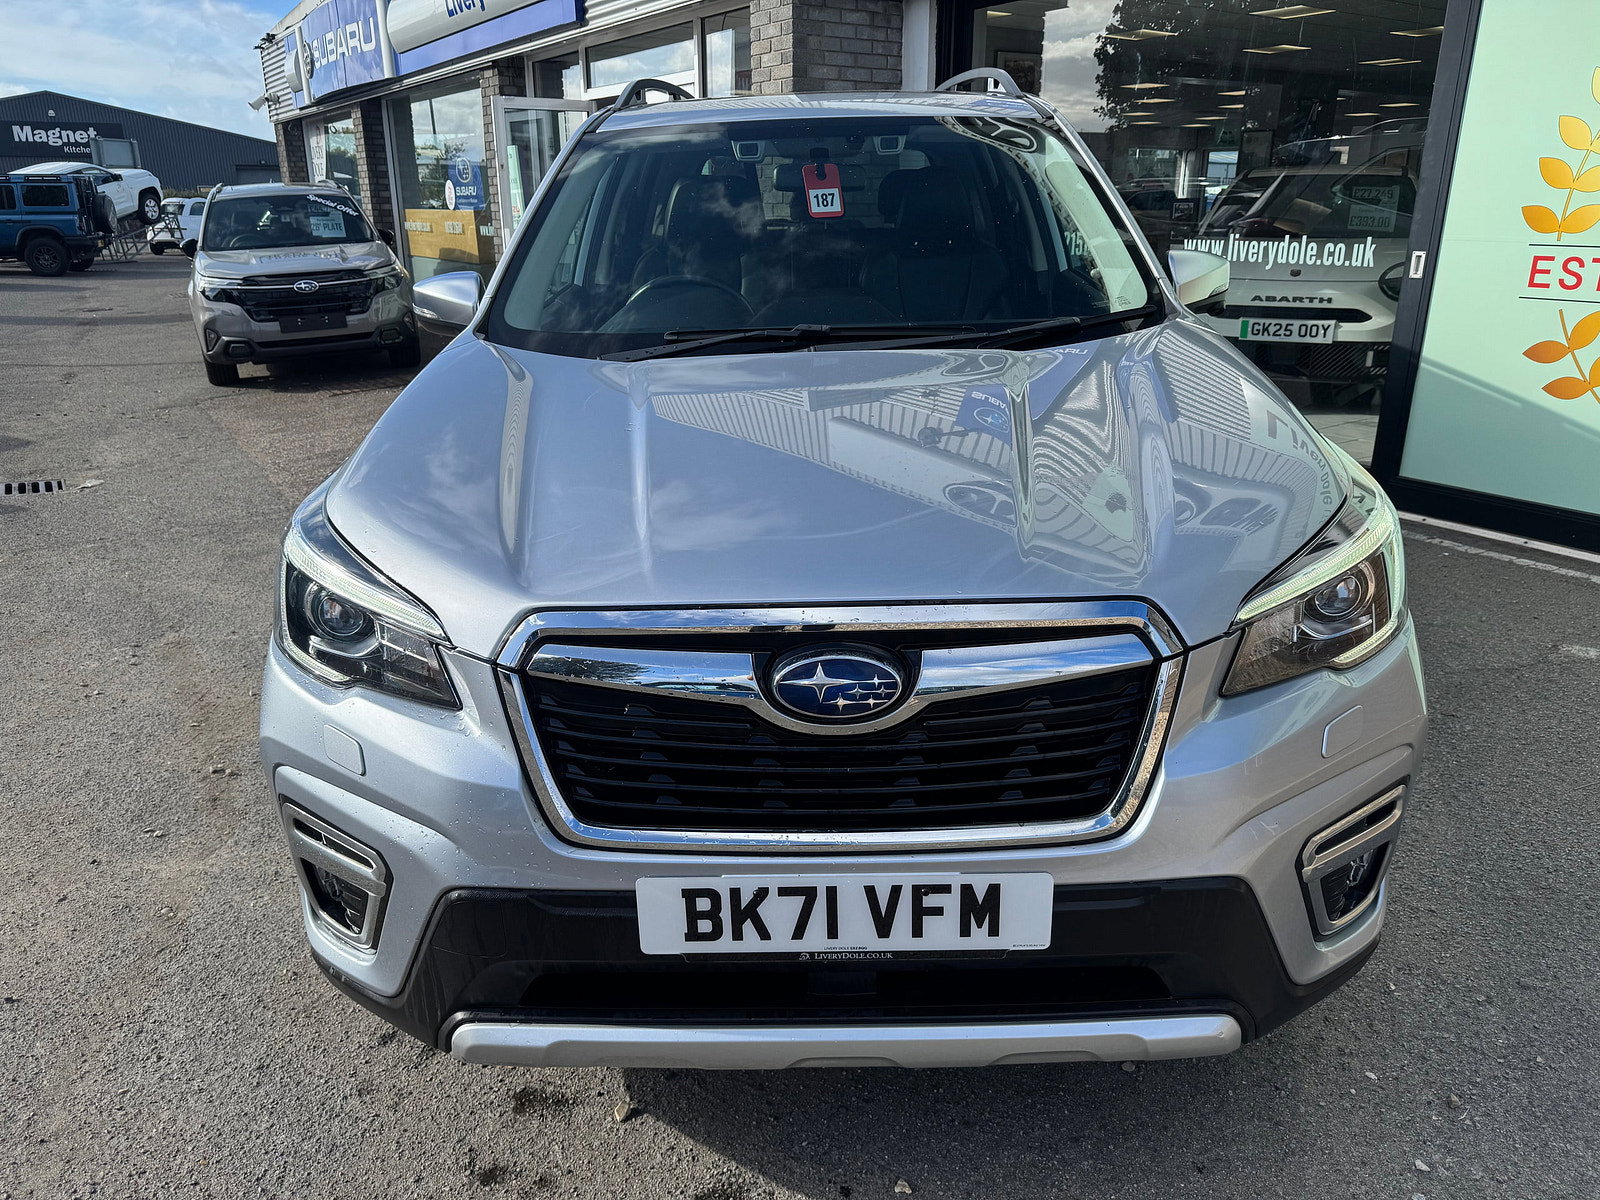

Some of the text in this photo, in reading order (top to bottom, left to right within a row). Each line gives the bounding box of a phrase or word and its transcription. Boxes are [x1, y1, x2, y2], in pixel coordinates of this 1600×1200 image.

[312, 17, 376, 69] SUBARU
[12, 125, 97, 146] Magnet
[64, 146, 92, 154] Kitche
[456, 186, 477, 196] SUBARU
[306, 194, 337, 208] Special
[337, 204, 359, 216] Offer
[813, 193, 835, 208] 187
[323, 223, 343, 231] PLATE
[1250, 295, 1333, 304] ABARTH
[1251, 322, 1294, 338] GK25
[680, 883, 1002, 943] BK71 VFM
